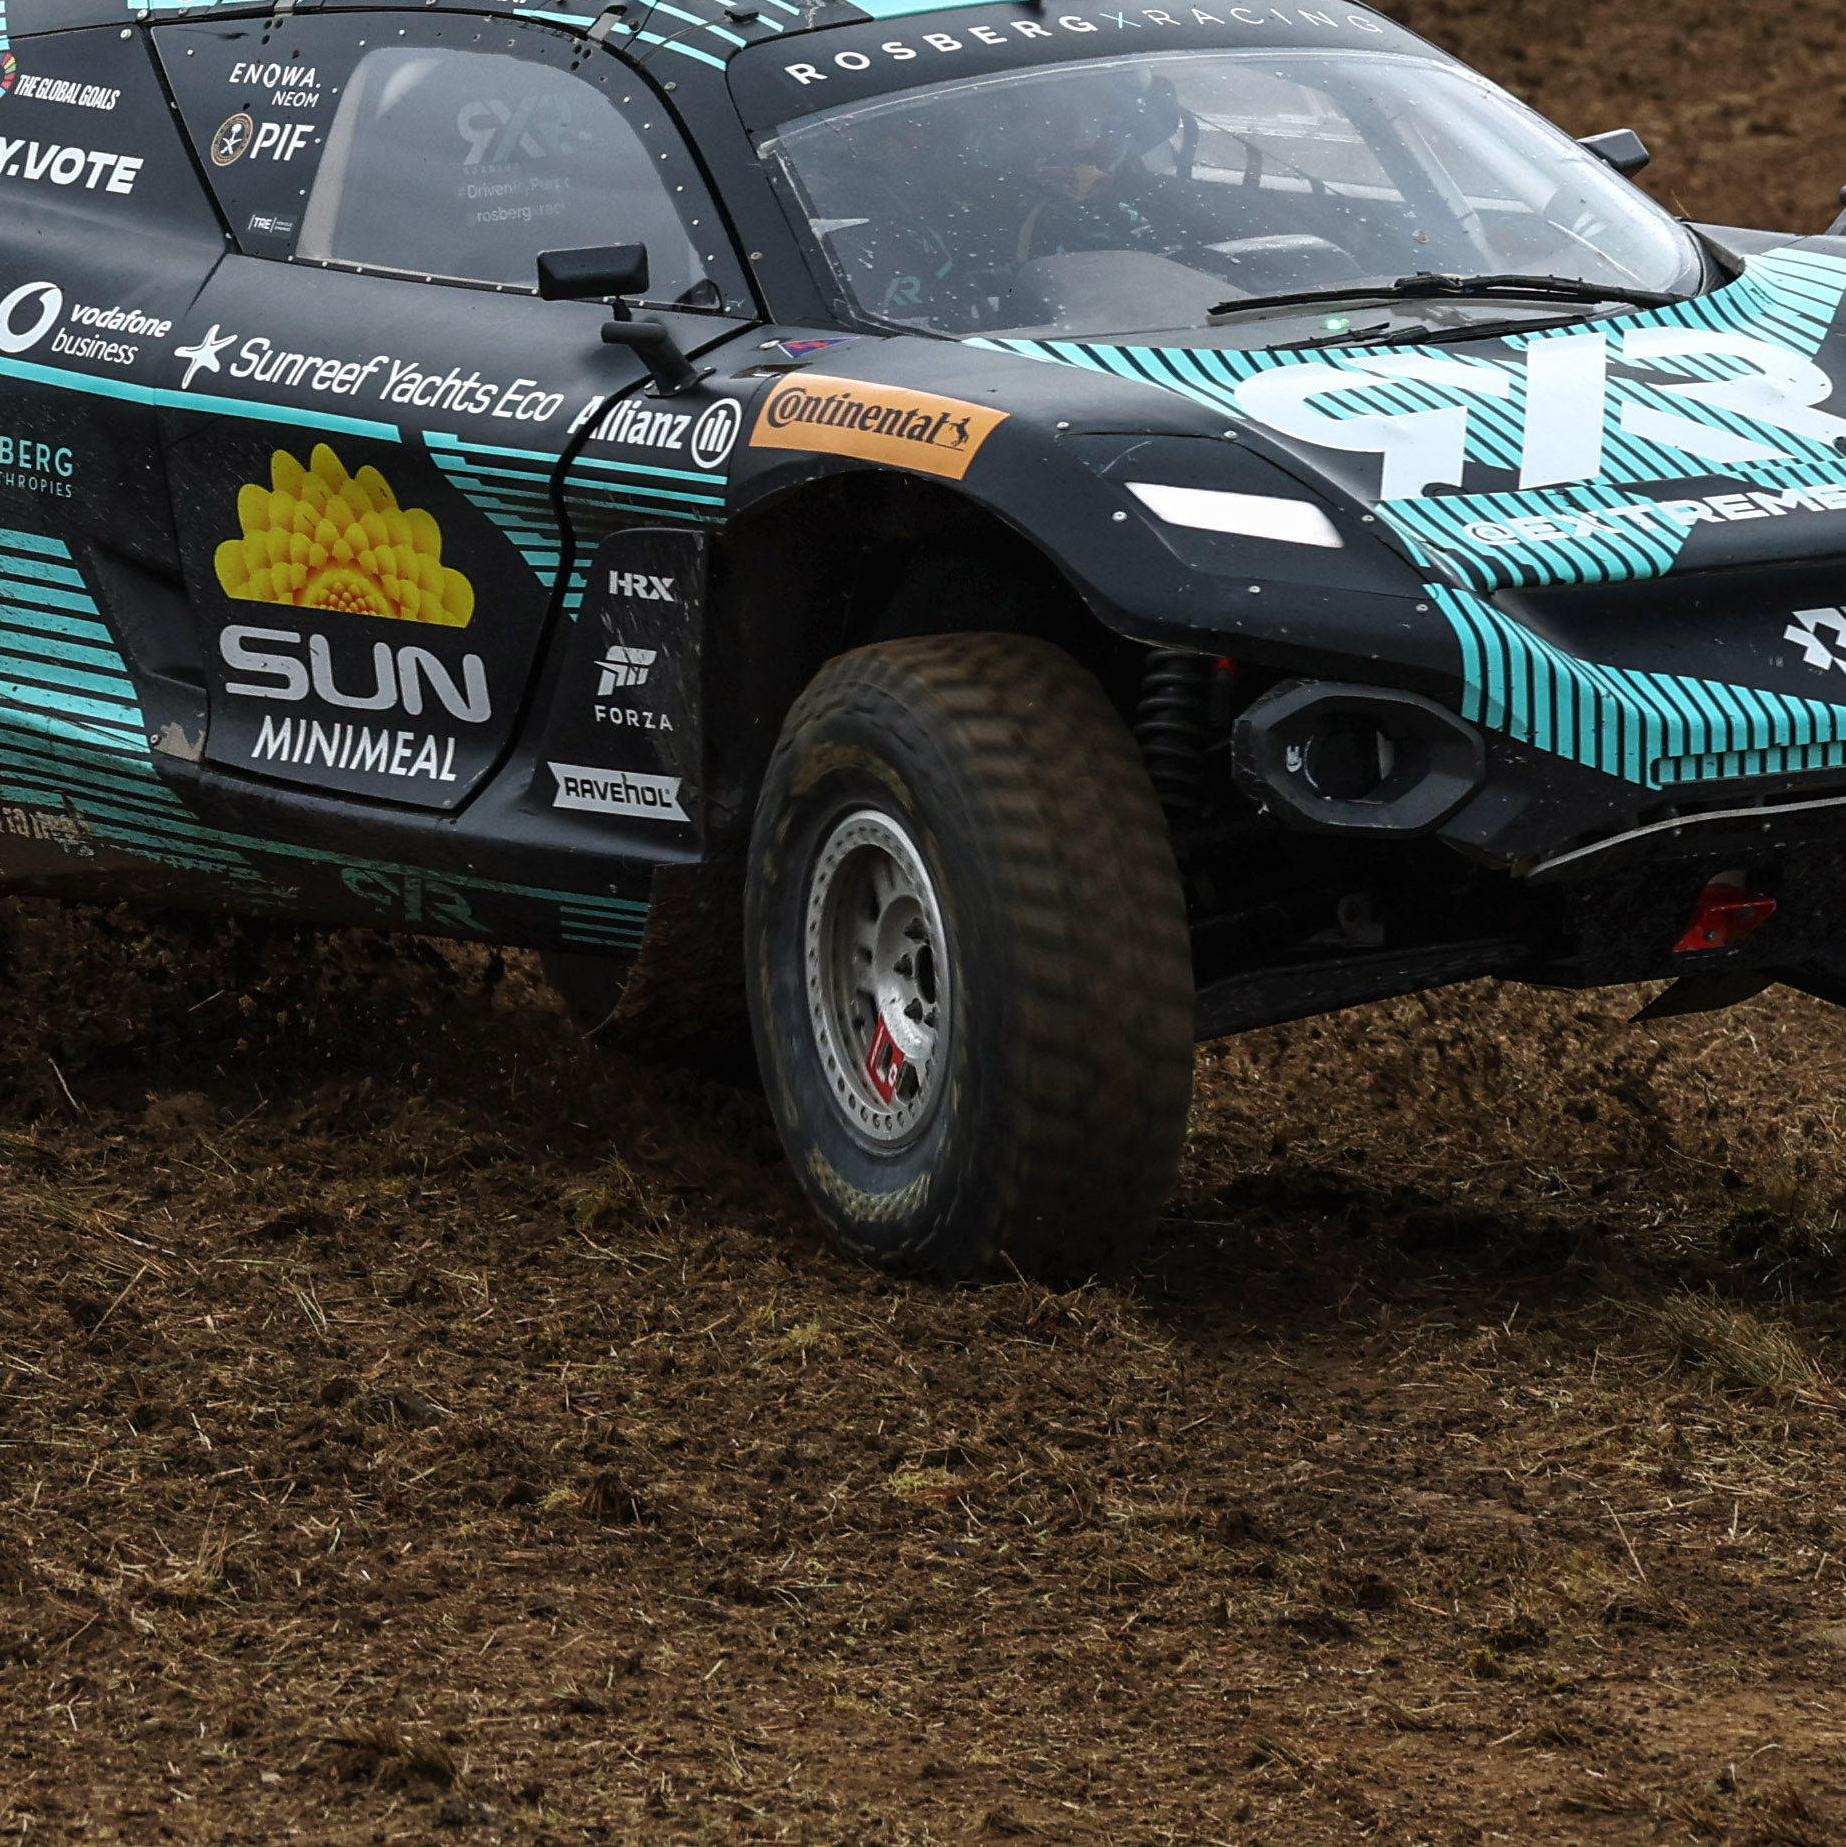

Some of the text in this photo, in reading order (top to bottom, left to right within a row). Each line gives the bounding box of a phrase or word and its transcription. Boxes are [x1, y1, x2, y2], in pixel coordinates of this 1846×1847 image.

[14, 74, 121, 110] THE GLOBAL GOALS
[271, 90, 319, 108] NEOM
[249, 122, 315, 161] PIF
[70, 303, 173, 338] vodafone
[51, 327, 139, 365] business
[229, 337, 565, 422] Sunreef Yachts Eco
[767, 386, 952, 445] Continental
[219, 624, 492, 723] SUN
[594, 705, 674, 731] FORZA
[251, 715, 457, 781] MINIMEAL
